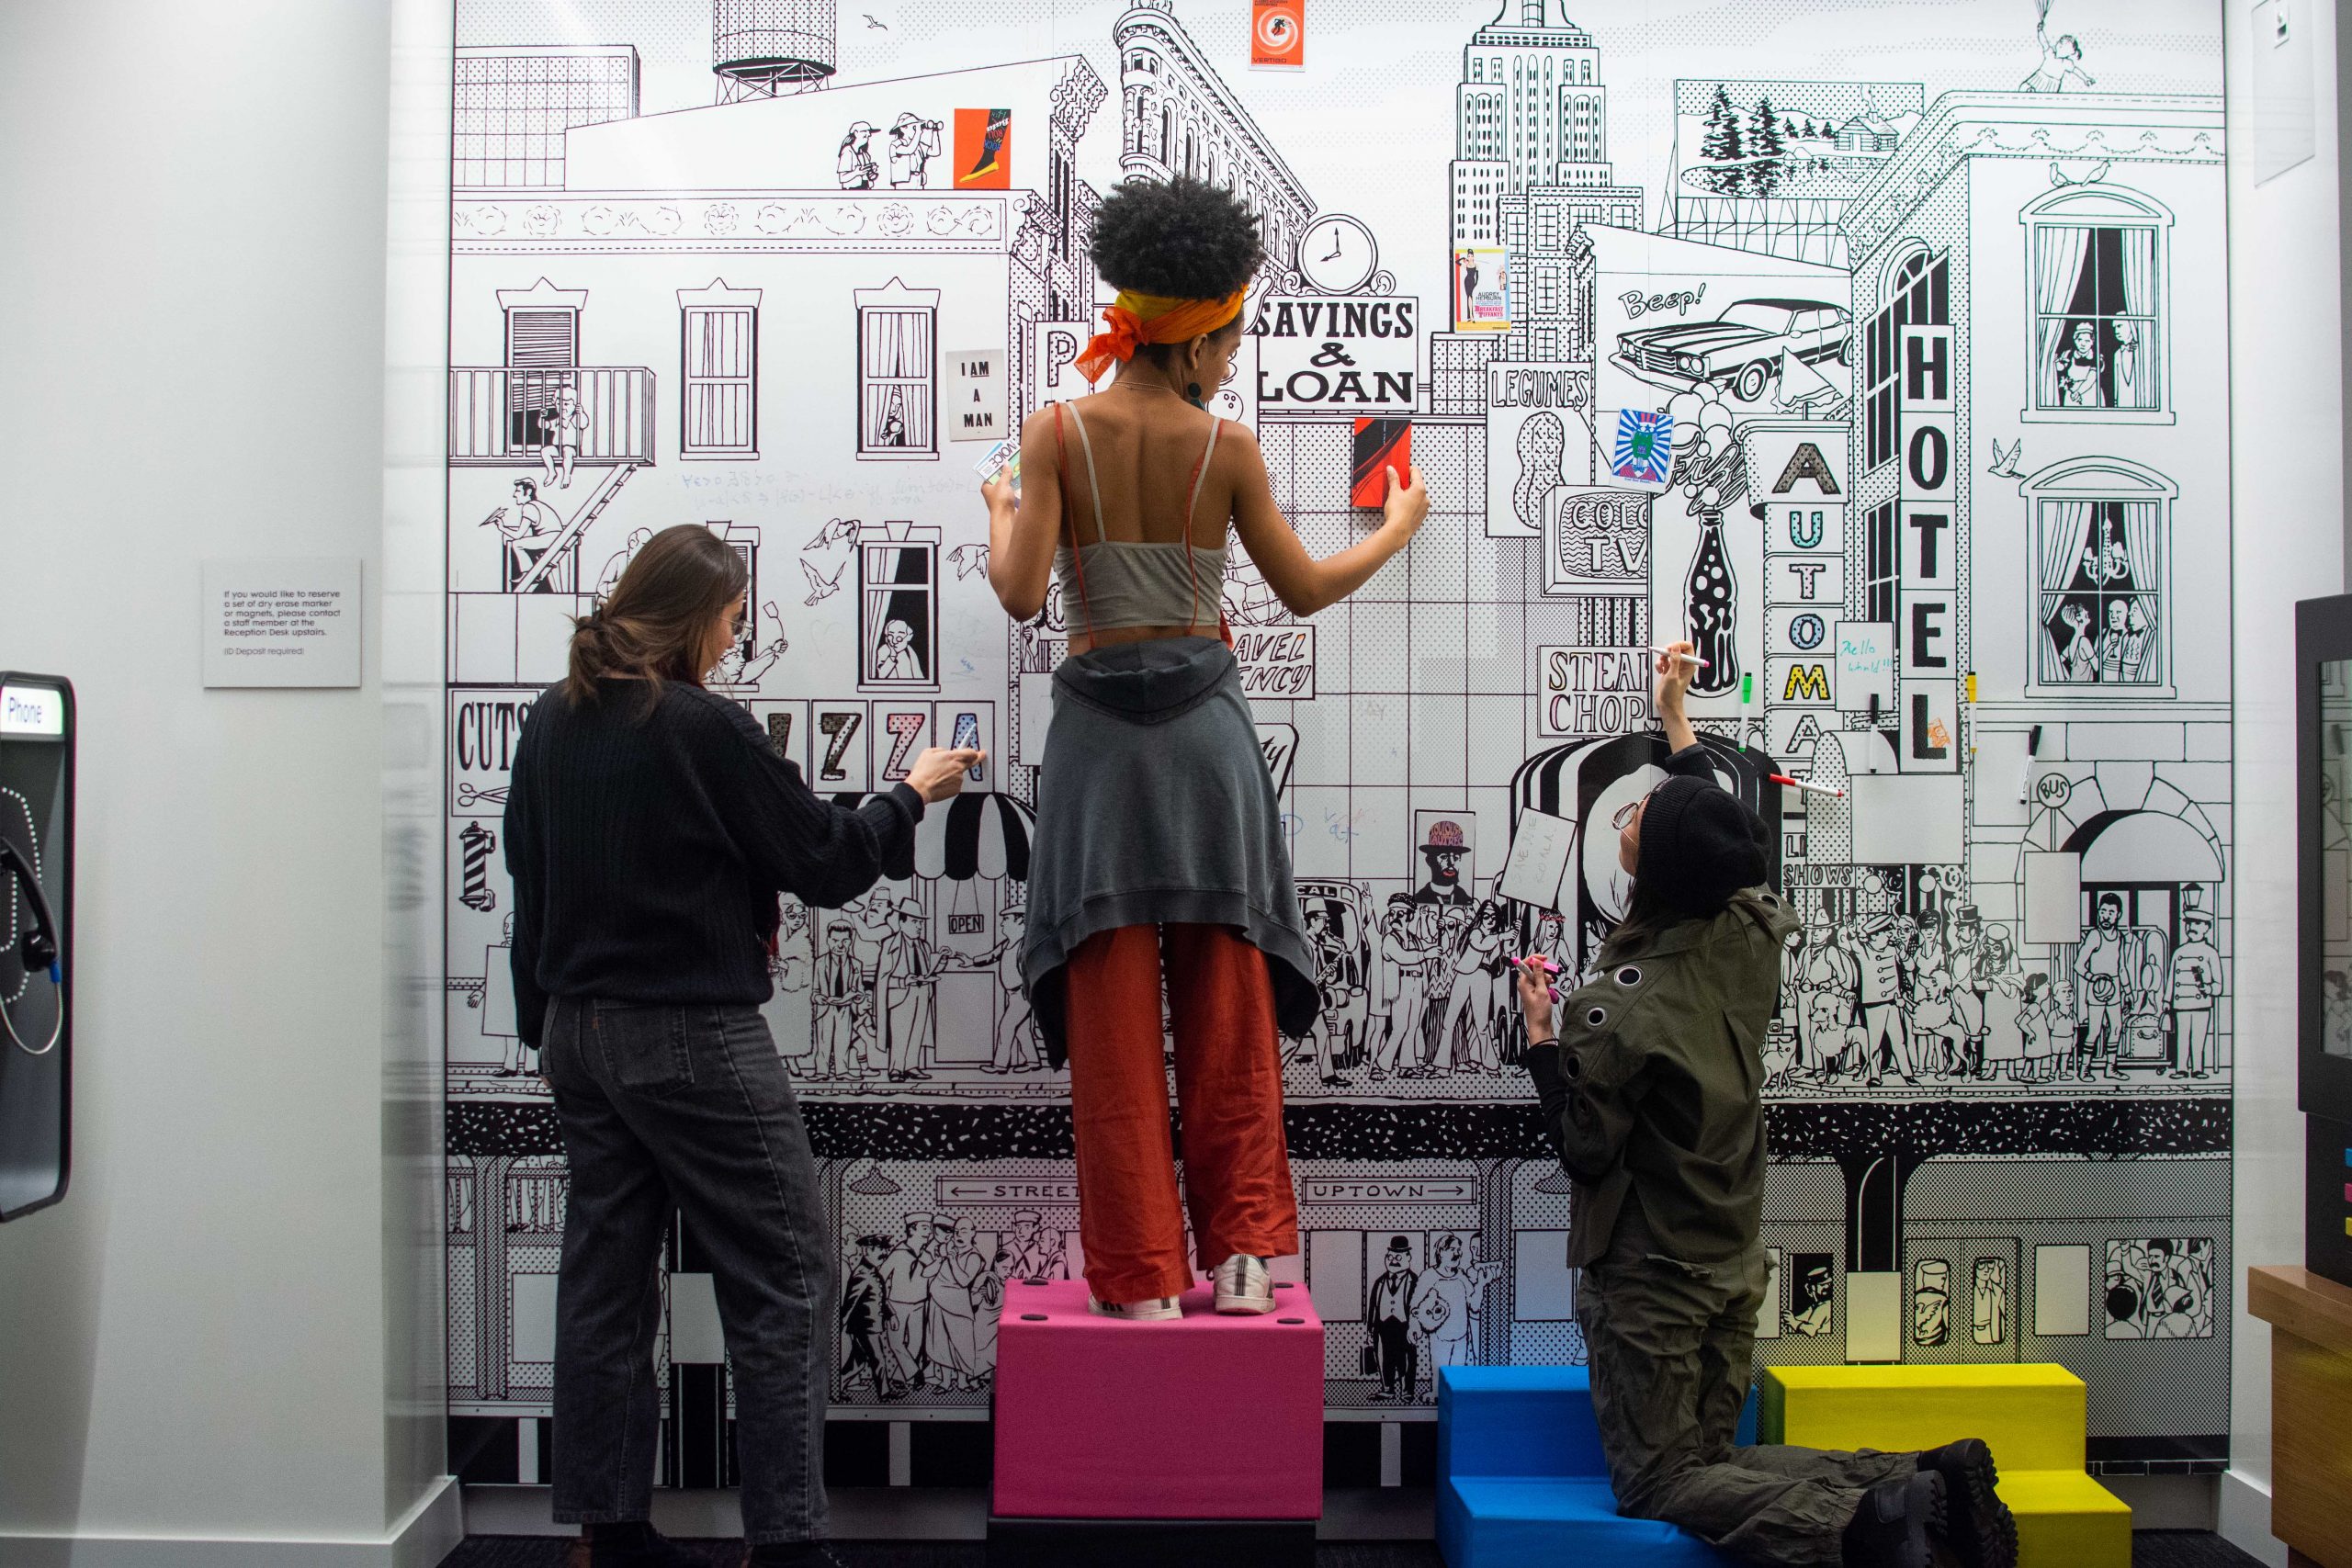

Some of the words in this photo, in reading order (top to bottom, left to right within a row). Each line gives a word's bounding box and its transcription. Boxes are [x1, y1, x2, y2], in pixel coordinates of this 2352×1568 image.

[1618, 282, 1706, 320] Beep!
[1252, 302, 1414, 338] SAVINGS
[1310, 342, 1357, 367] &
[961, 362, 966, 376] I
[970, 361, 989, 378] AM
[974, 389, 980, 402] A
[1260, 370, 1414, 403] LOAN
[1491, 369, 1589, 408] LEGUMES
[964, 412, 993, 428] MAN
[989, 442, 1017, 468] VOICE
[1584, 536, 1647, 573] TV
[1907, 335, 1950, 760] HOTEL
[224, 590, 231, 598] If
[232, 592, 248, 600] you
[251, 590, 277, 598] would
[280, 590, 295, 598] like
[247, 600, 255, 608] of
[258, 600, 273, 609] dry
[302, 600, 333, 608] marker
[277, 609, 307, 619] please
[309, 609, 341, 617] contact
[224, 628, 267, 637] Reception
[269, 628, 289, 637] Desk
[1233, 632, 1306, 662] AVEL
[8, 696, 42, 724] Phone
[2040, 779, 2068, 799] BUS
[1782, 863, 1854, 886] SHOWS
[1295, 886, 1337, 897] CAL
[950, 916, 981, 932] OPEN
[1313, 1185, 1424, 1197] UPTOWN
